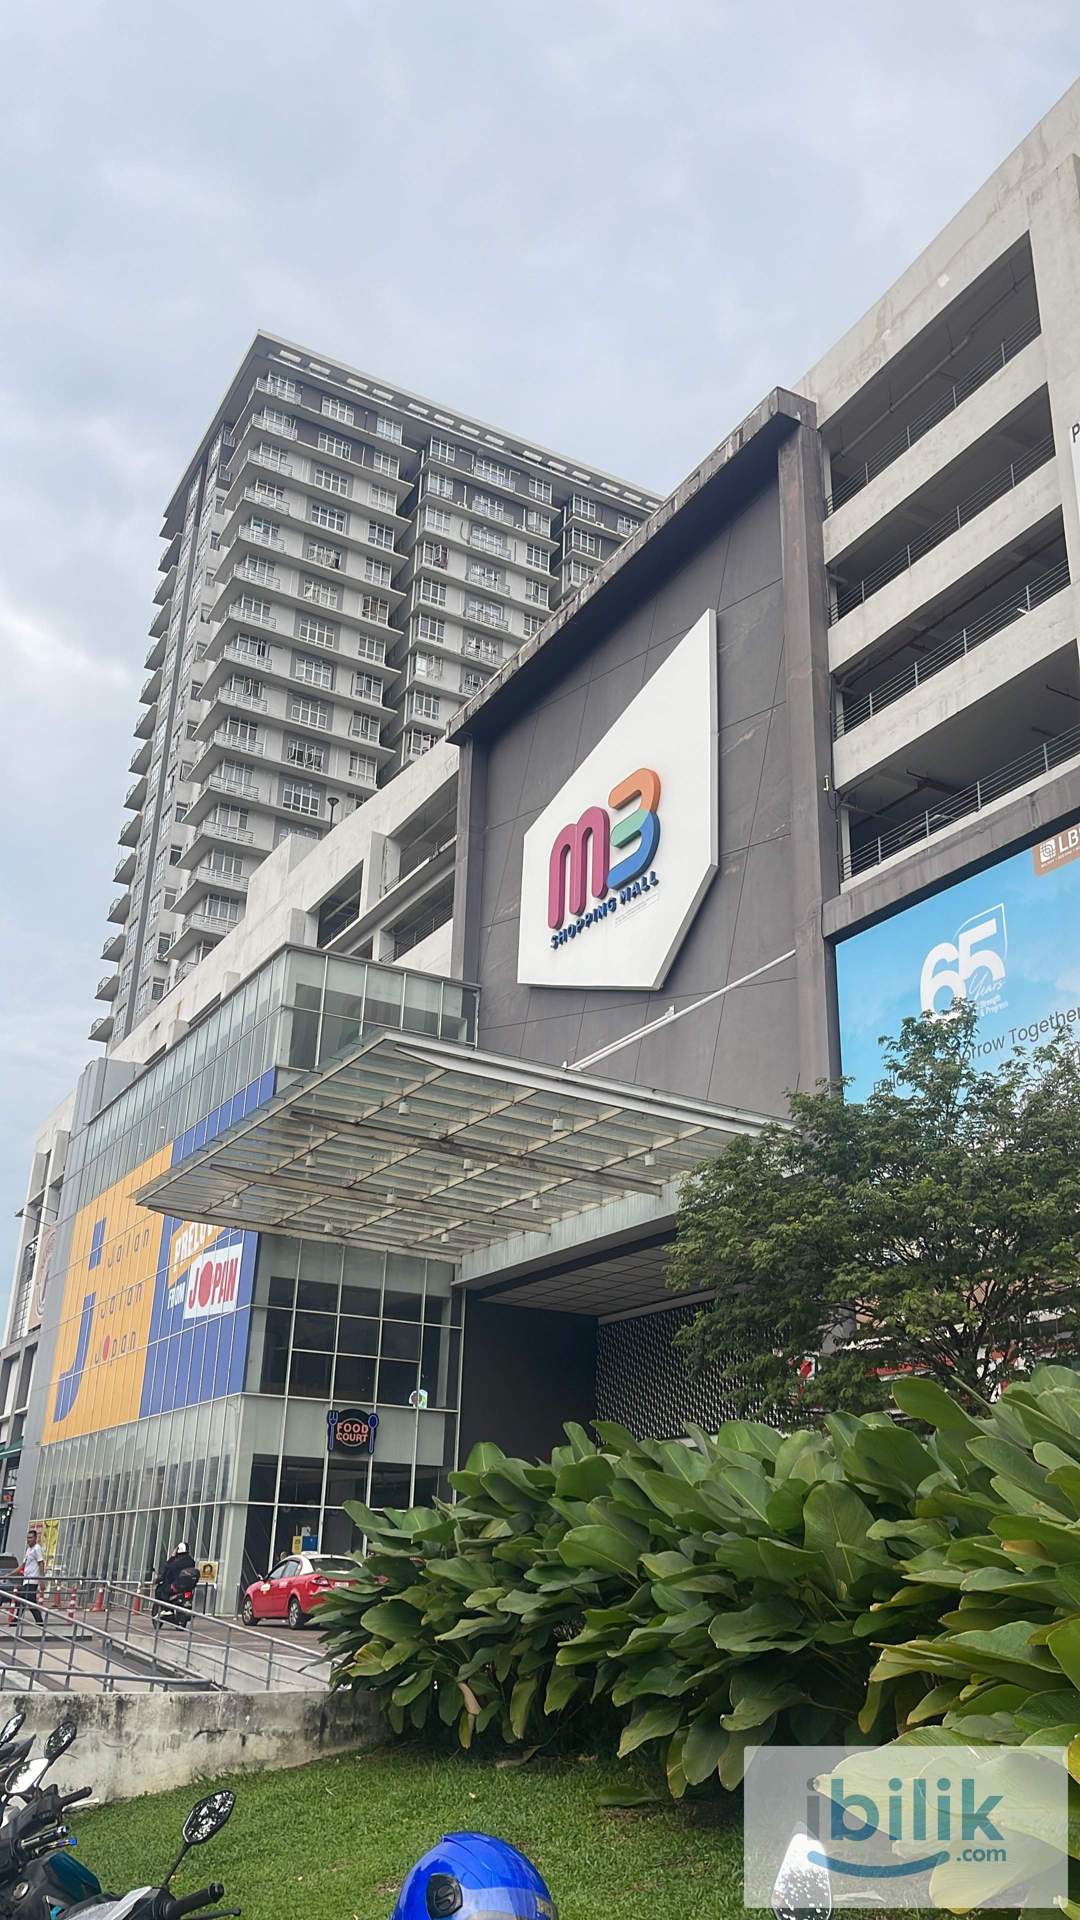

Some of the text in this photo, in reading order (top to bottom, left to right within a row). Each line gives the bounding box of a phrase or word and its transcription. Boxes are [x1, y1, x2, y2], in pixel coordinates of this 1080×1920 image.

[1059, 826, 1080, 853] LB
[550, 897, 617, 950] SHOPPING
[619, 870, 660, 905] MALL
[920, 917, 1006, 1025] 65
[335, 1432, 369, 1442] COURT
[336, 1422, 369, 1434] FOOD
